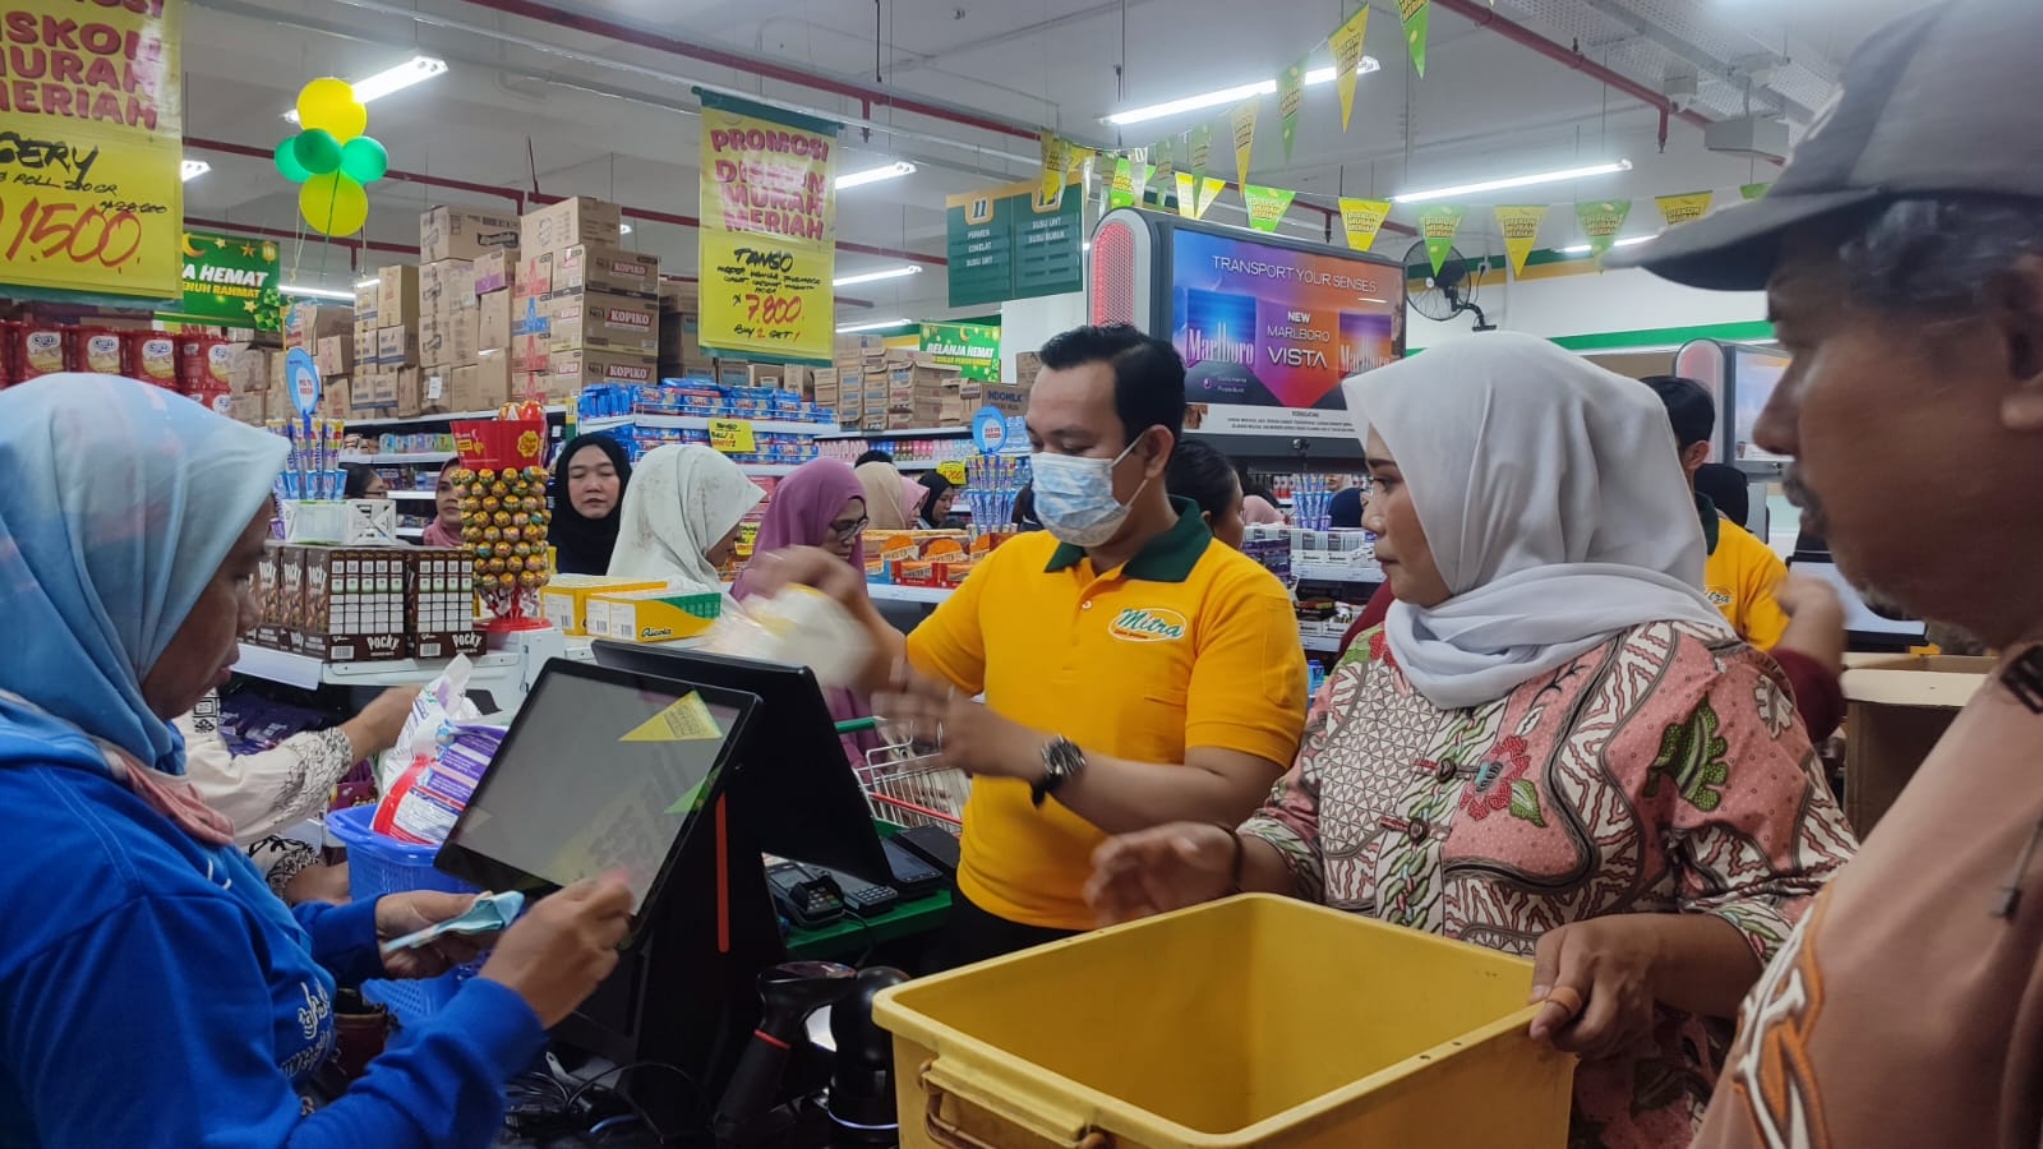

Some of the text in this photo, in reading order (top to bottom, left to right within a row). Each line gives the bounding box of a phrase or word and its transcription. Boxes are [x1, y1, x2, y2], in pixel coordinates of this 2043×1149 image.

[0, 46, 156, 98] URAH
[710, 129, 829, 163] PROMOSI
[722, 184, 825, 218] MURAH
[723, 208, 824, 241] MERIAH
[199, 265, 269, 287] HEMAT
[613, 262, 647, 275] KOPIKO
[1212, 255, 1378, 297] TRANSPORT YOUR SENSES
[611, 309, 650, 325] KOPIKO
[1287, 311, 1311, 324] NEW
[1187, 320, 1255, 366] Marlboro
[1267, 325, 1331, 343] MARLBORO
[1267, 346, 1328, 369] VISTA
[609, 364, 648, 379] KOPIKO
[1117, 608, 1182, 638] Mitra
